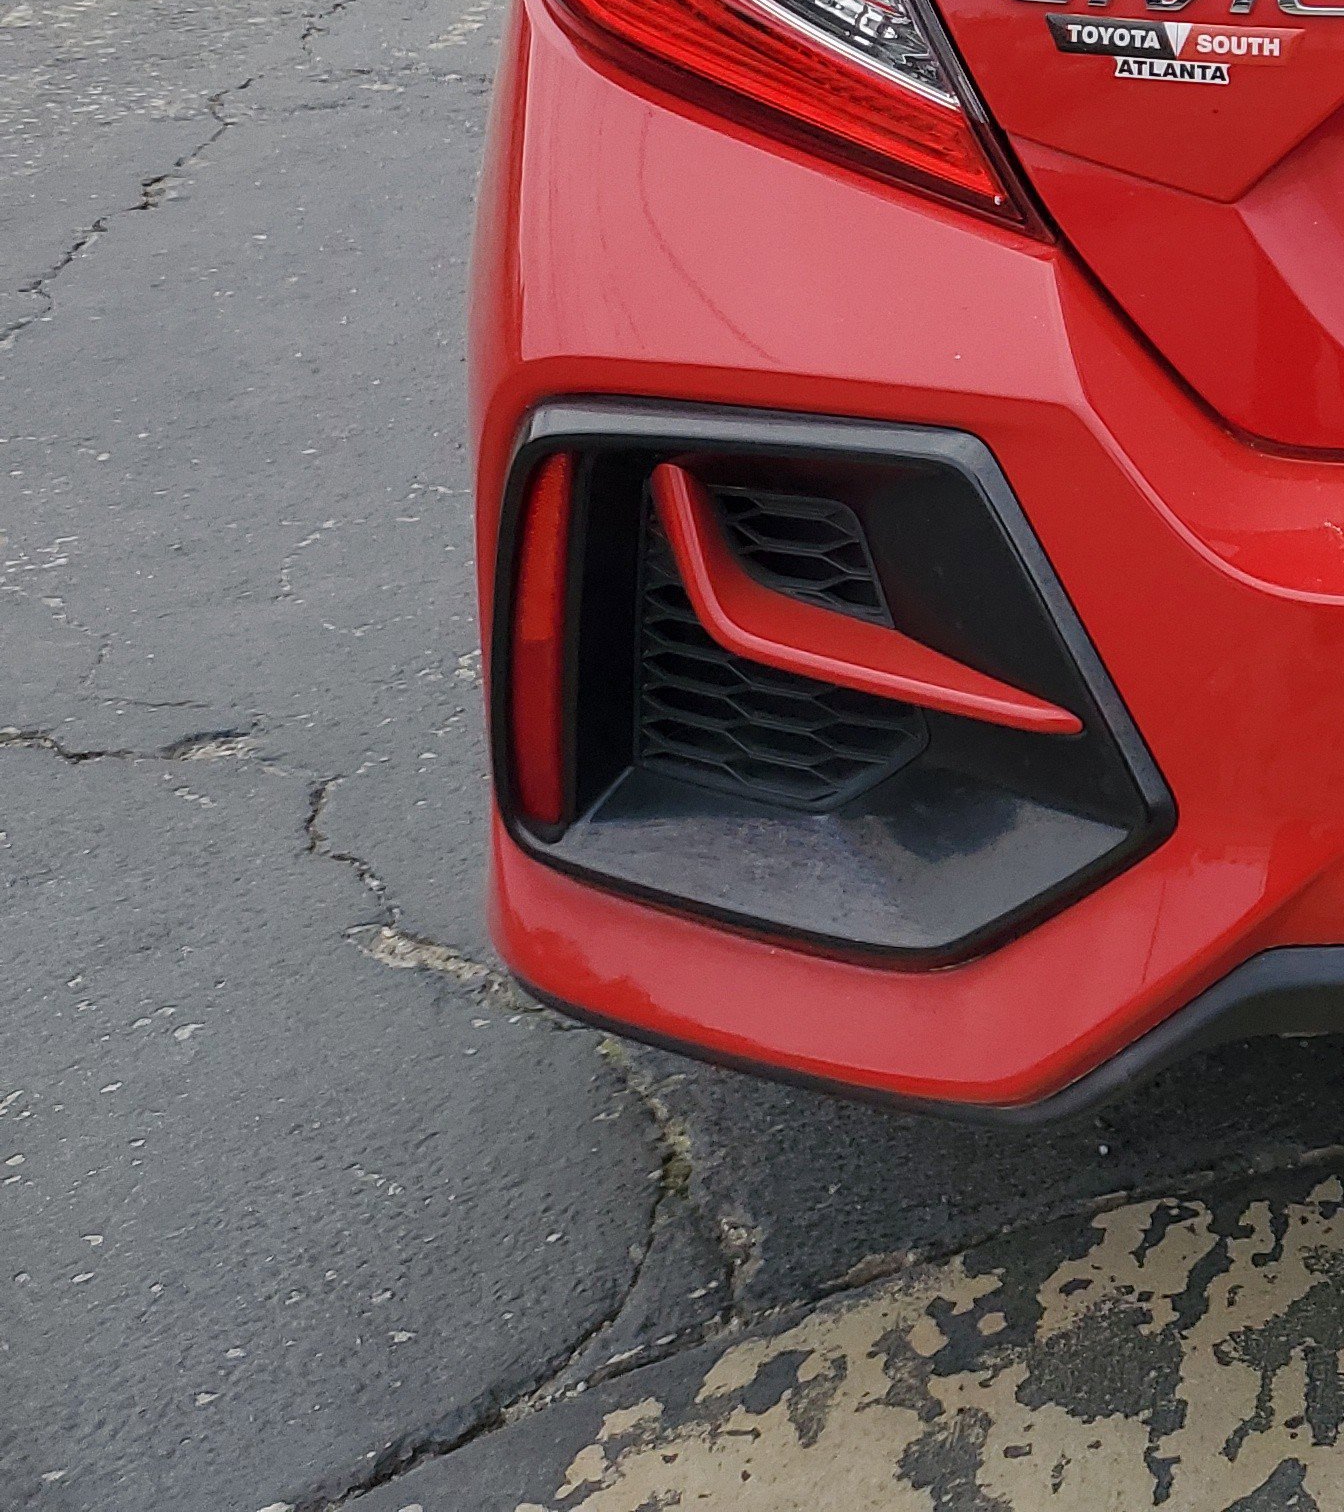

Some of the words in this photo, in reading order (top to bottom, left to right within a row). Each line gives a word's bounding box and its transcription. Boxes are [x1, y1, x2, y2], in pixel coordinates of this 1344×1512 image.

[1067, 24, 1162, 50] TOYOTA
[1196, 35, 1280, 57] SOUTH
[1118, 59, 1227, 82] ATLANTA
